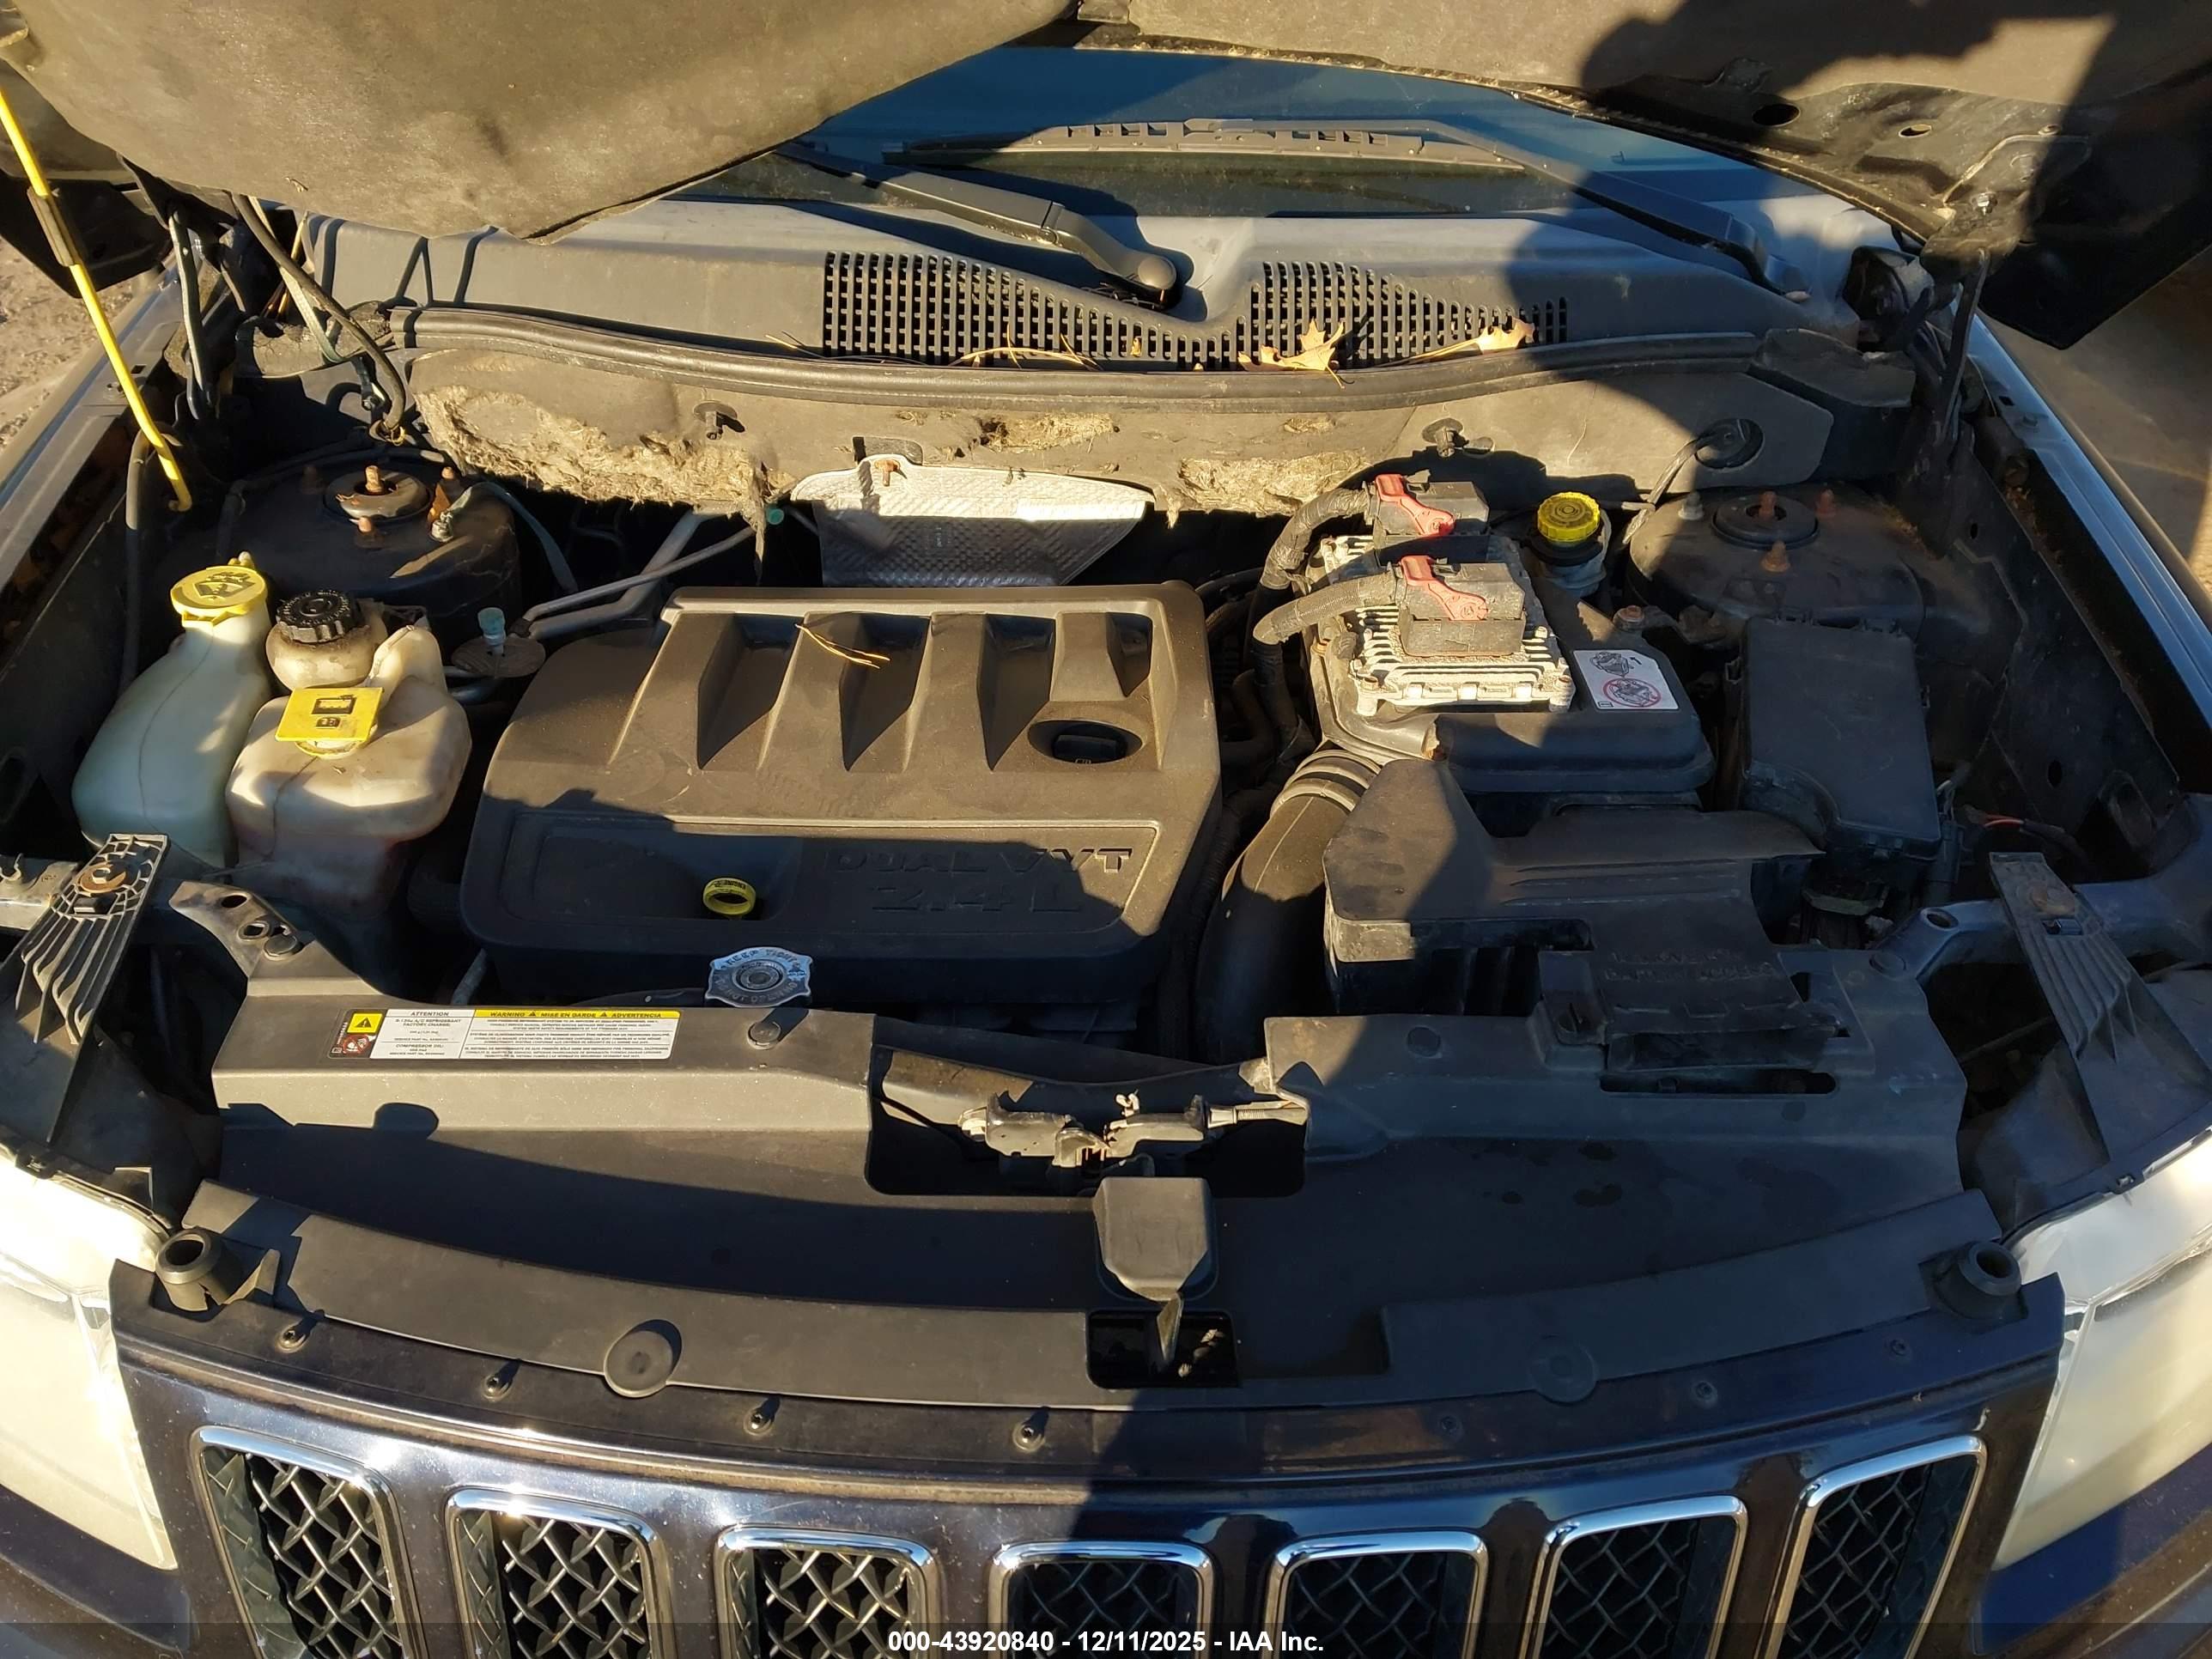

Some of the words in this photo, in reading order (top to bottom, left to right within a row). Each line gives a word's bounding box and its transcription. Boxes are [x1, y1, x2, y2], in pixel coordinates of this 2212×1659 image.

[823, 849, 988, 873] DUAL
[999, 847, 1134, 873] VVT
[726, 949, 759, 965] KEEP
